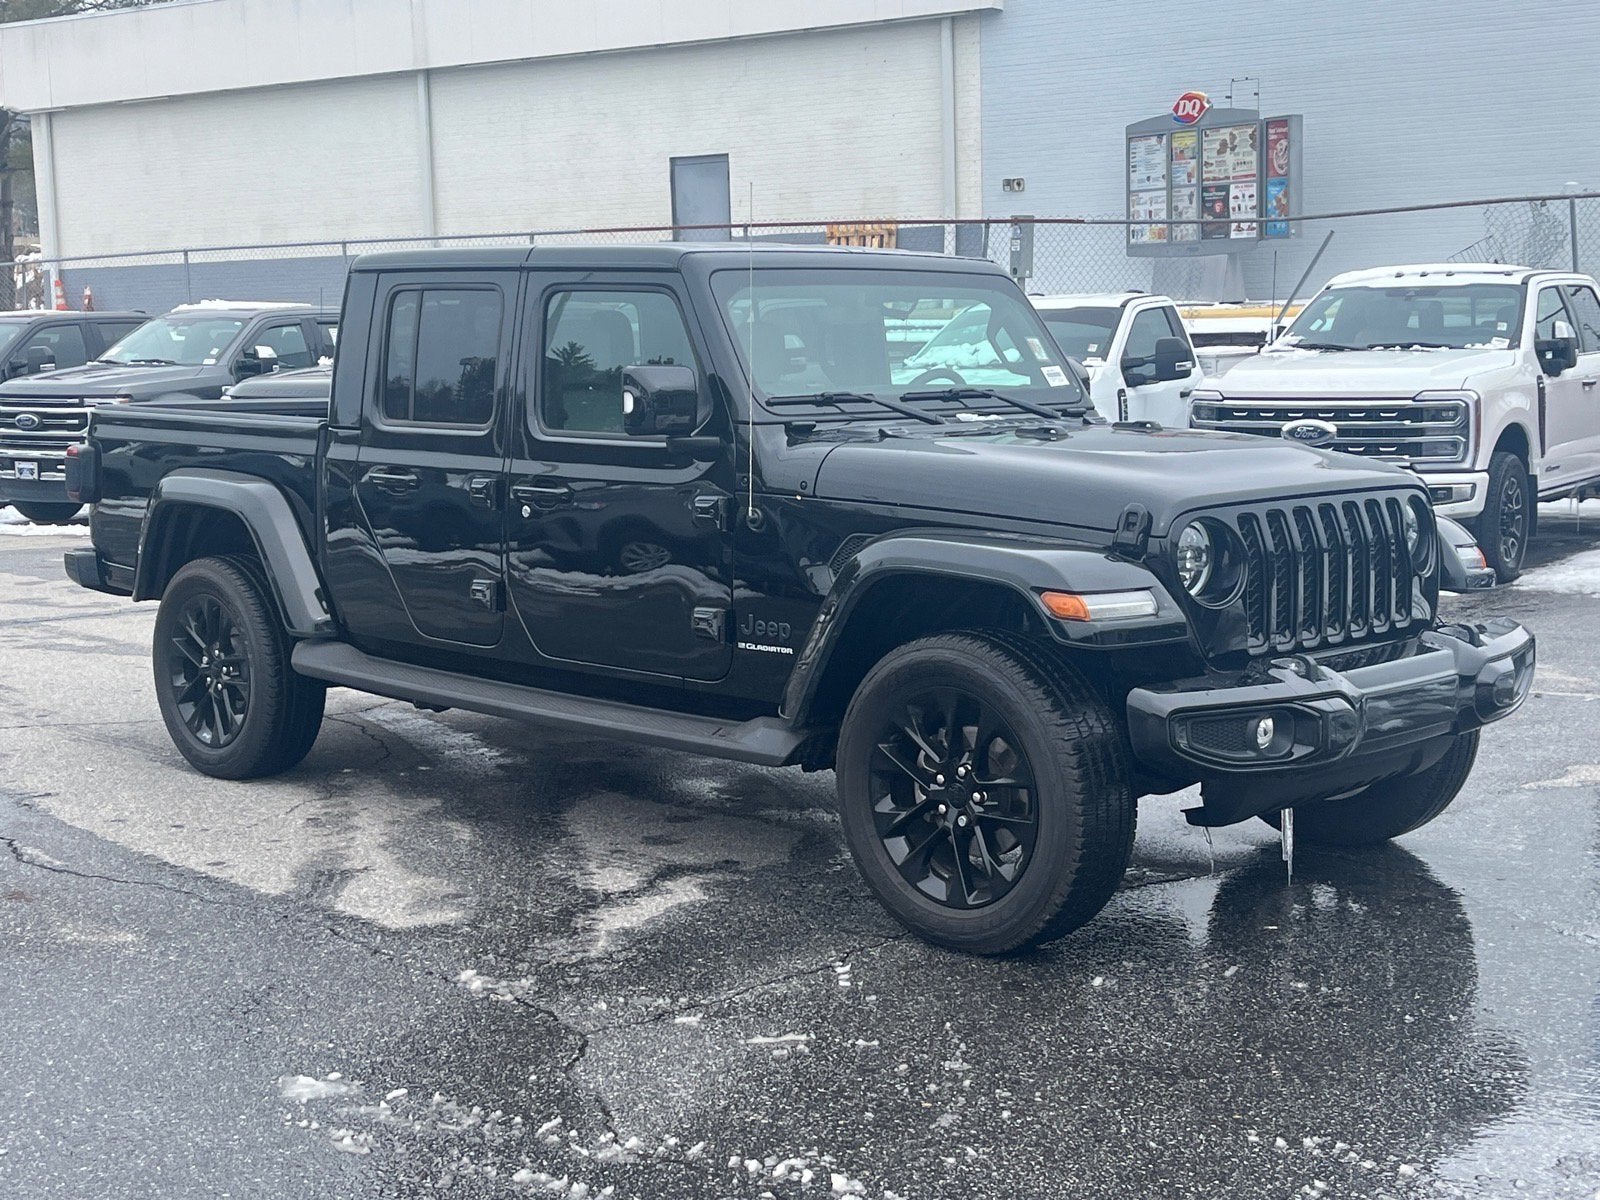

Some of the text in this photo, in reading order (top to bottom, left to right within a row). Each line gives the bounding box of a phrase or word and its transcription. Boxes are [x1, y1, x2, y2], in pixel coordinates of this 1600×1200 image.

[1177, 99, 1201, 117] DQ
[1294, 426, 1320, 438] Ford
[740, 614, 791, 641] Jeep
[745, 642, 793, 655] GLADIATOR
